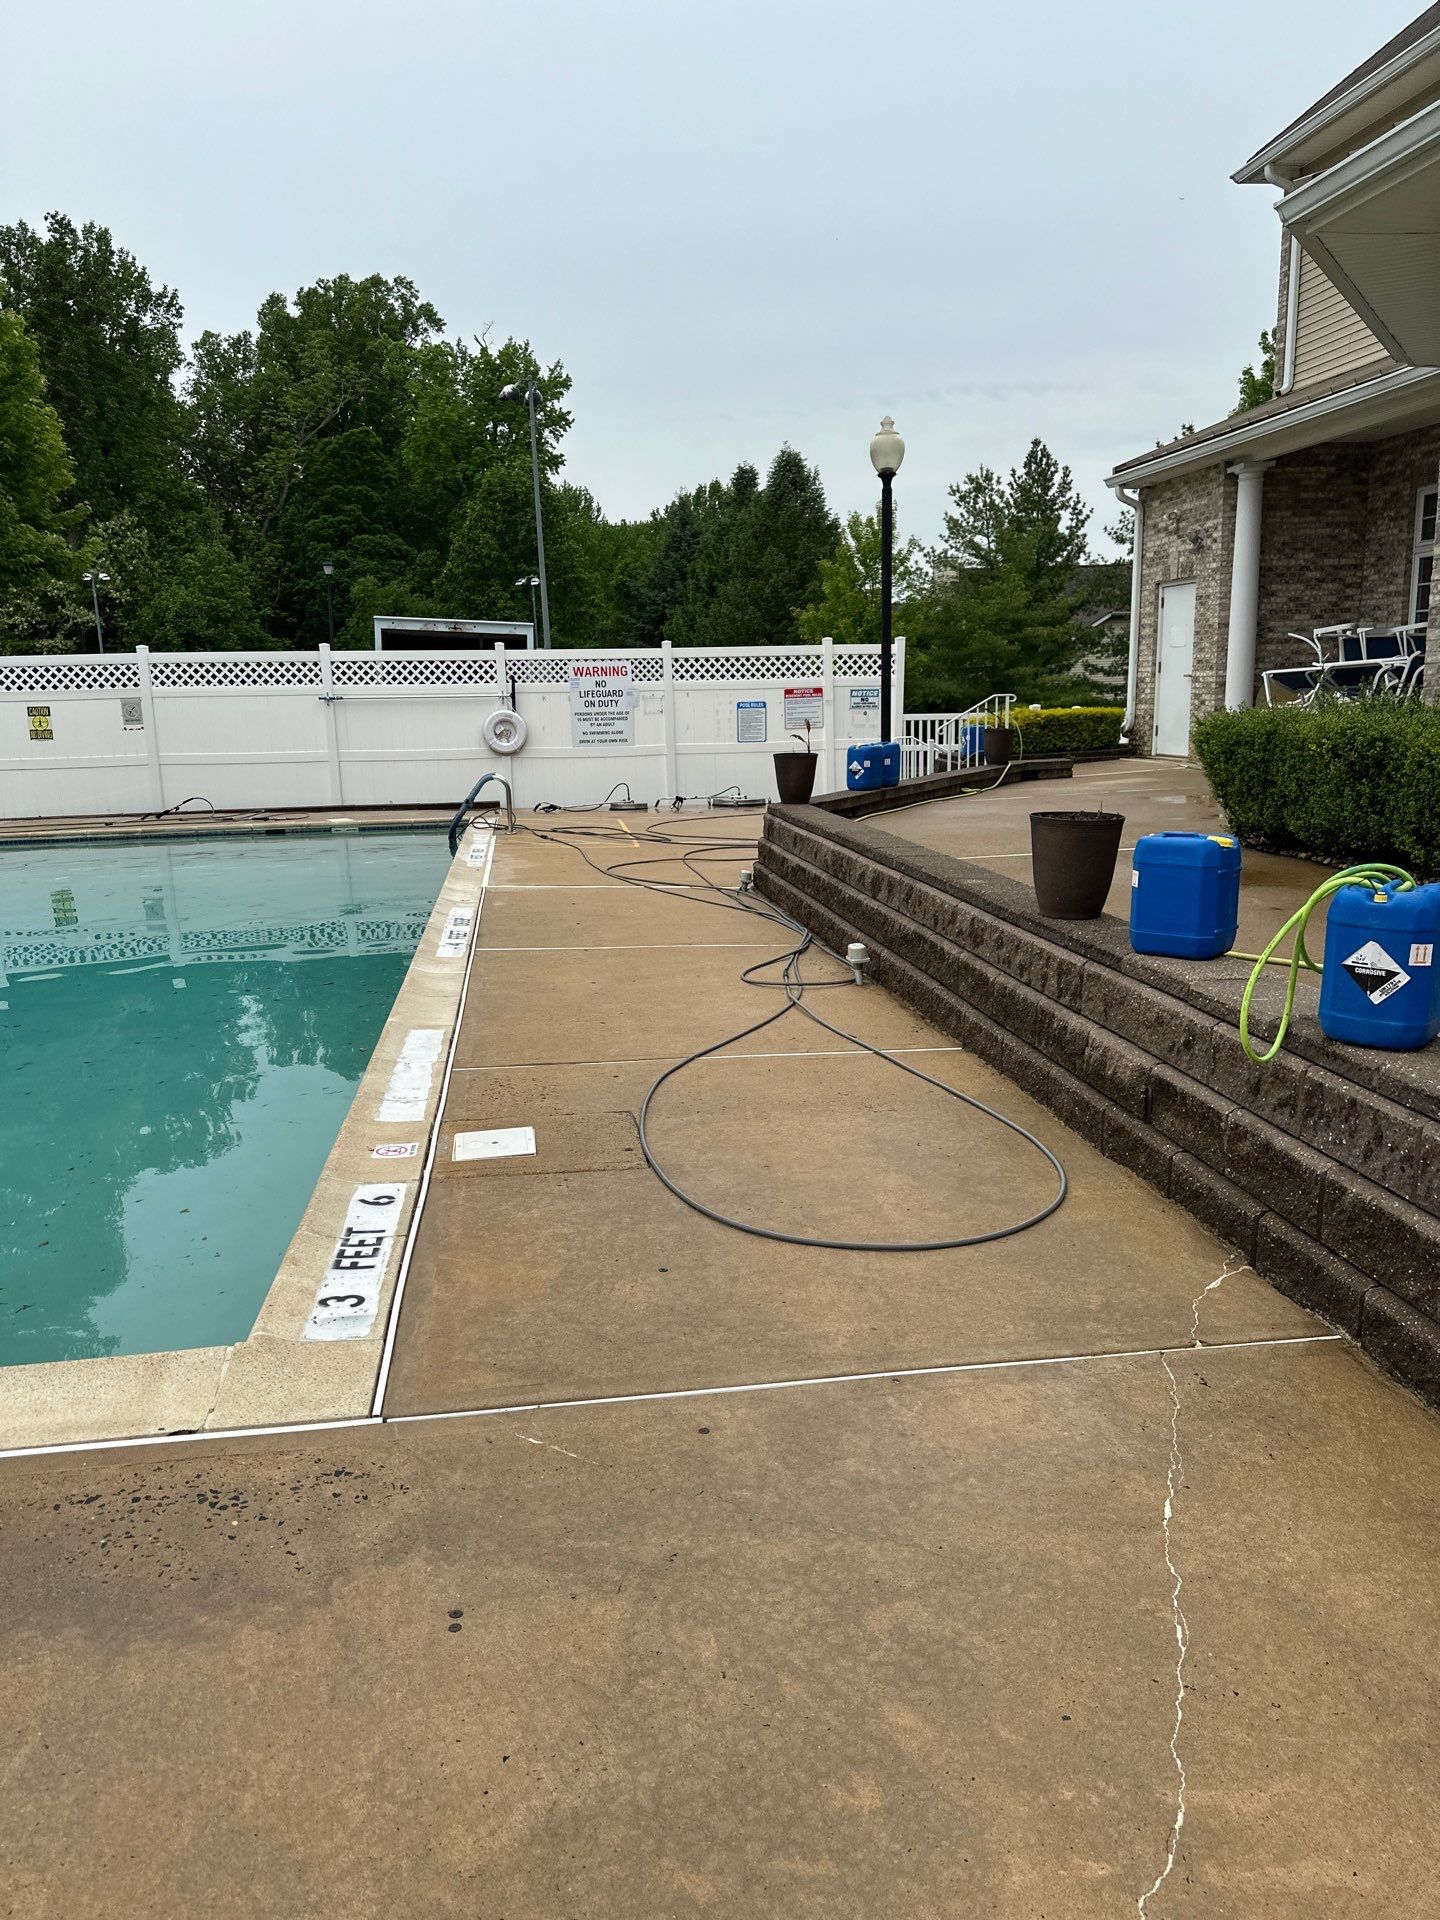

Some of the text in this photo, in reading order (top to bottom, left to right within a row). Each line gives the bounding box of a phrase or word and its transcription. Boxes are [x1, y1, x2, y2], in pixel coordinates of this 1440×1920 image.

[572, 666, 628, 677] WARNING
[595, 680, 607, 688] NO
[579, 690, 624, 698] LIFEGUARD
[584, 699, 619, 708] ON DUTY
[28, 707, 49, 716] CAUTION
[31, 730, 53, 739] NO DIVING
[1354, 968, 1386, 976] CORROSIVE
[318, 1195, 396, 1308] 3 FEET 6
